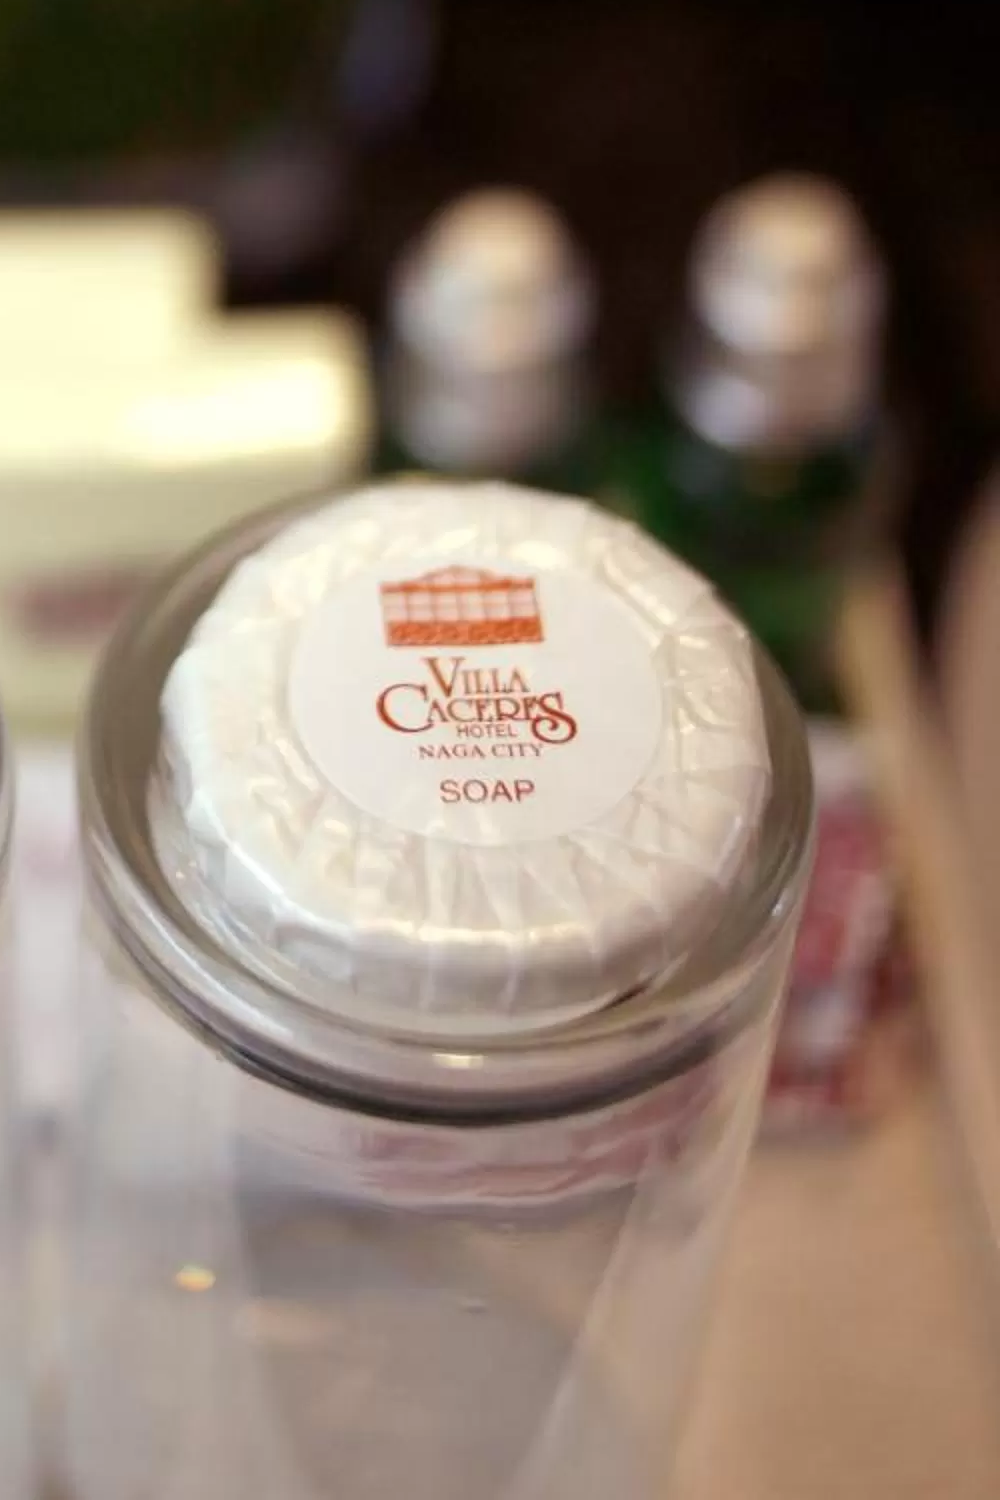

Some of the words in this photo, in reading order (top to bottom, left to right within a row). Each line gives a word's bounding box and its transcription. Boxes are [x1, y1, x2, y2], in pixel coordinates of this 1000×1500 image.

[423, 656, 531, 698] VILLA
[375, 683, 577, 744] CACERES
[456, 723, 518, 738] HOTEL
[418, 743, 485, 760] NAGA
[491, 742, 543, 758] CITY
[440, 779, 535, 804] SOAP
